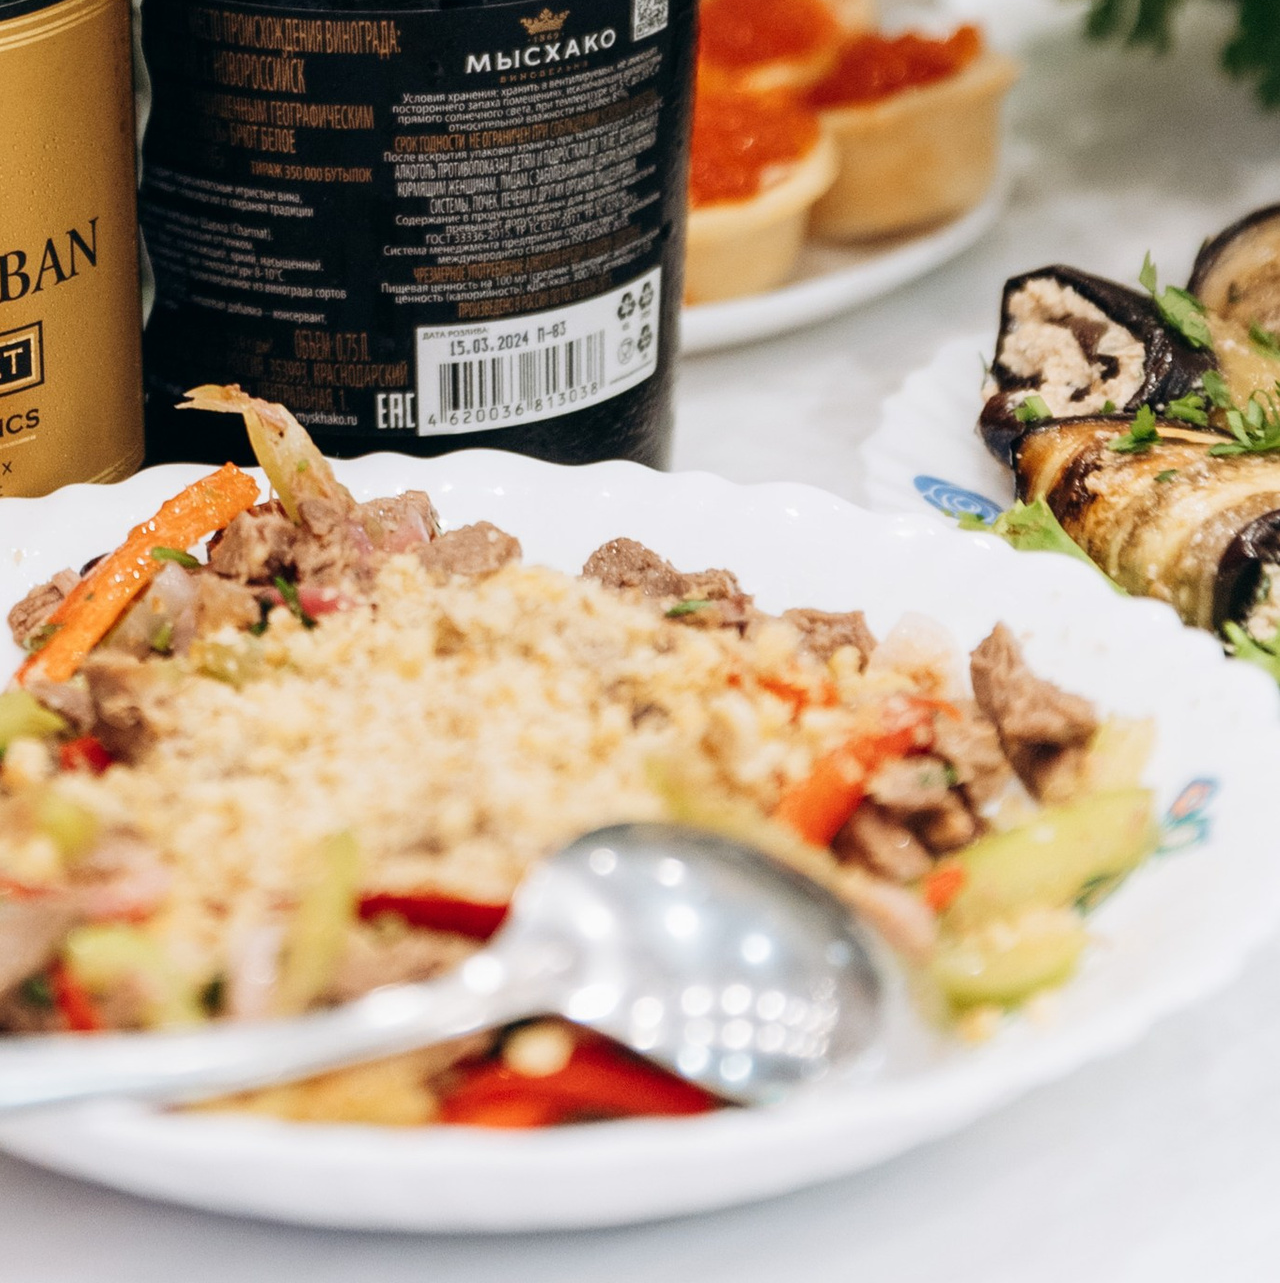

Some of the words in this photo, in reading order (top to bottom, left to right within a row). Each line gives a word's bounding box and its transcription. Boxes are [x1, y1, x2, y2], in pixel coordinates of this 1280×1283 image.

[223, 11, 323, 56] ПРОИСХОЖДЕНИЯ
[324, 20, 402, 60] ВИНОГРАДА:
[464, 28, 617, 75] МЫСХАКО
[214, 49, 307, 93] НОВОРОССИЙСК
[402, 92, 446, 104] Условия
[448, 88, 497, 103] хранения:
[501, 83, 540, 98] хранить
[270, 100, 374, 130] ГЕОГРАФИЧЕСКИМ
[392, 103, 465, 116] постороннего
[468, 99, 501, 111] запаха
[398, 113, 443, 126] прямого
[445, 109, 504, 122] солнечного
[448, 115, 524, 132] относительной
[525, 108, 575, 124] влажности
[261, 126, 297, 154] БЕЛОЕ
[394, 135, 417, 152] СРОК
[419, 133, 466, 153] ГОДНОСТИ
[469, 132, 480, 149] НЕ
[482, 127, 531, 148] ОГРАНИЧЕН
[383, 151, 416, 162] После
[418, 151, 467, 163] вскрытия
[469, 145, 516, 159] упаковки
[518, 138, 556, 153] хранить
[284, 164, 302, 181] 350
[304, 165, 322, 182] 000
[324, 167, 373, 183] БУТЫЛОК
[394, 163, 436, 180] АЛКОГОЛЬ
[437, 157, 510, 178] ПРОТИВОПОКАЗАН
[511, 152, 536, 173] ДЕТЯМ
[234, 186, 277, 201] игристые
[277, 192, 303, 204] вина,
[397, 180, 447, 197] КОРМЯЩИМ
[228, 199, 268, 212] сохраняя
[269, 205, 314, 218] традиции
[429, 197, 472, 214] СИСТЕМЫ,
[500, 188, 531, 209] ПЕЧЕНИ
[395, 215, 460, 227] Содержание
[471, 207, 525, 222] продукции
[445, 221, 502, 235] превышает
[383, 245, 427, 256] Система
[429, 240, 500, 255] менеджмента
[425, 233, 451, 245] ГОСТ
[437, 246, 524, 264] международного
[252, 282, 264, 292] из
[265, 284, 313, 298] винограда
[314, 287, 348, 301] сортов
[381, 282, 429, 295] Пищевая
[430, 282, 479, 295] ценность
[481, 280, 493, 288] на
[495, 276, 512, 287] 100
[395, 294, 444, 305] ценность
[272, 309, 328, 325] консервант,
[421, 331, 446, 341] ДАТА
[450, 330, 529, 357] 15.03.2024
[312, 361, 408, 388] КРАСНОДАРСКИЙ
[376, 391, 417, 430] EAC
